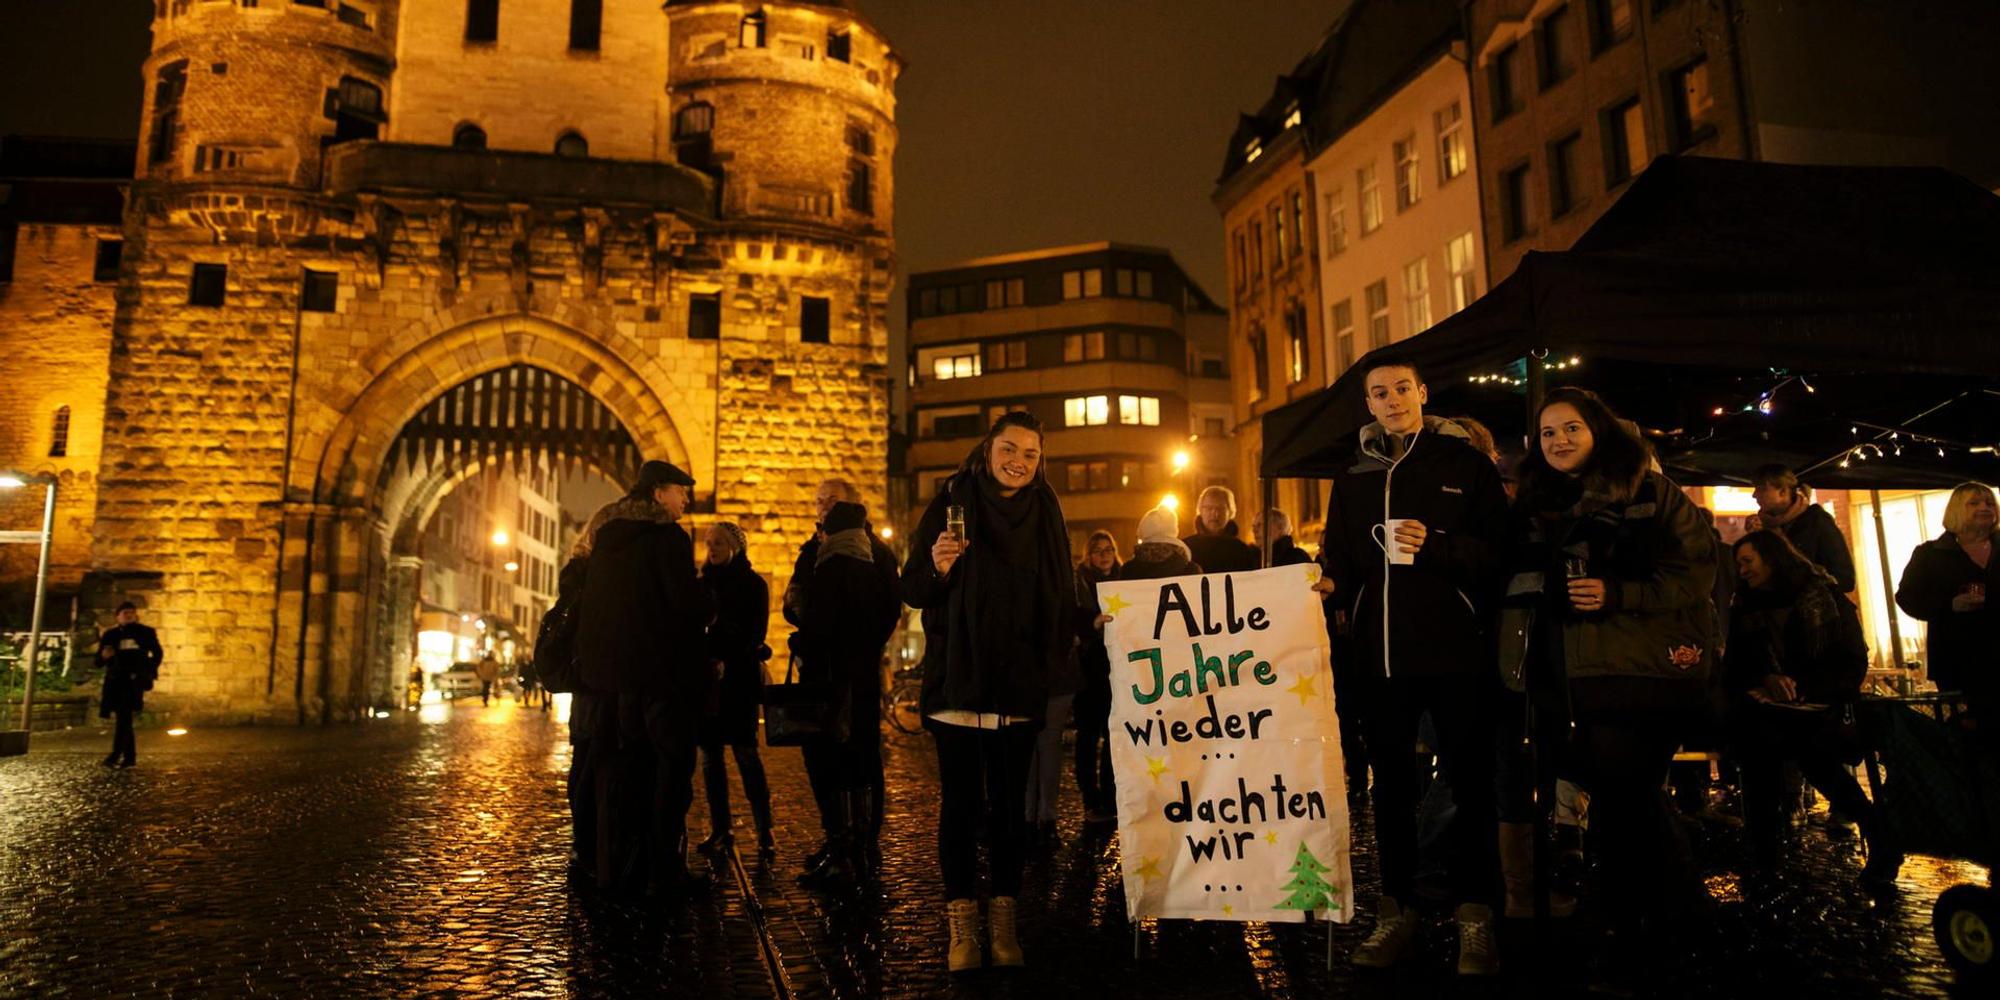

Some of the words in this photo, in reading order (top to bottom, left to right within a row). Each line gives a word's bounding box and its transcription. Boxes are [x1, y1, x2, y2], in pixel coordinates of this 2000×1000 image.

[1153, 574, 1270, 640] Alle
[1128, 643, 1277, 705] Jahre
[1125, 695, 1272, 746] wieder
[1164, 774, 1326, 824] dachten
[1186, 828, 1255, 864] wir
